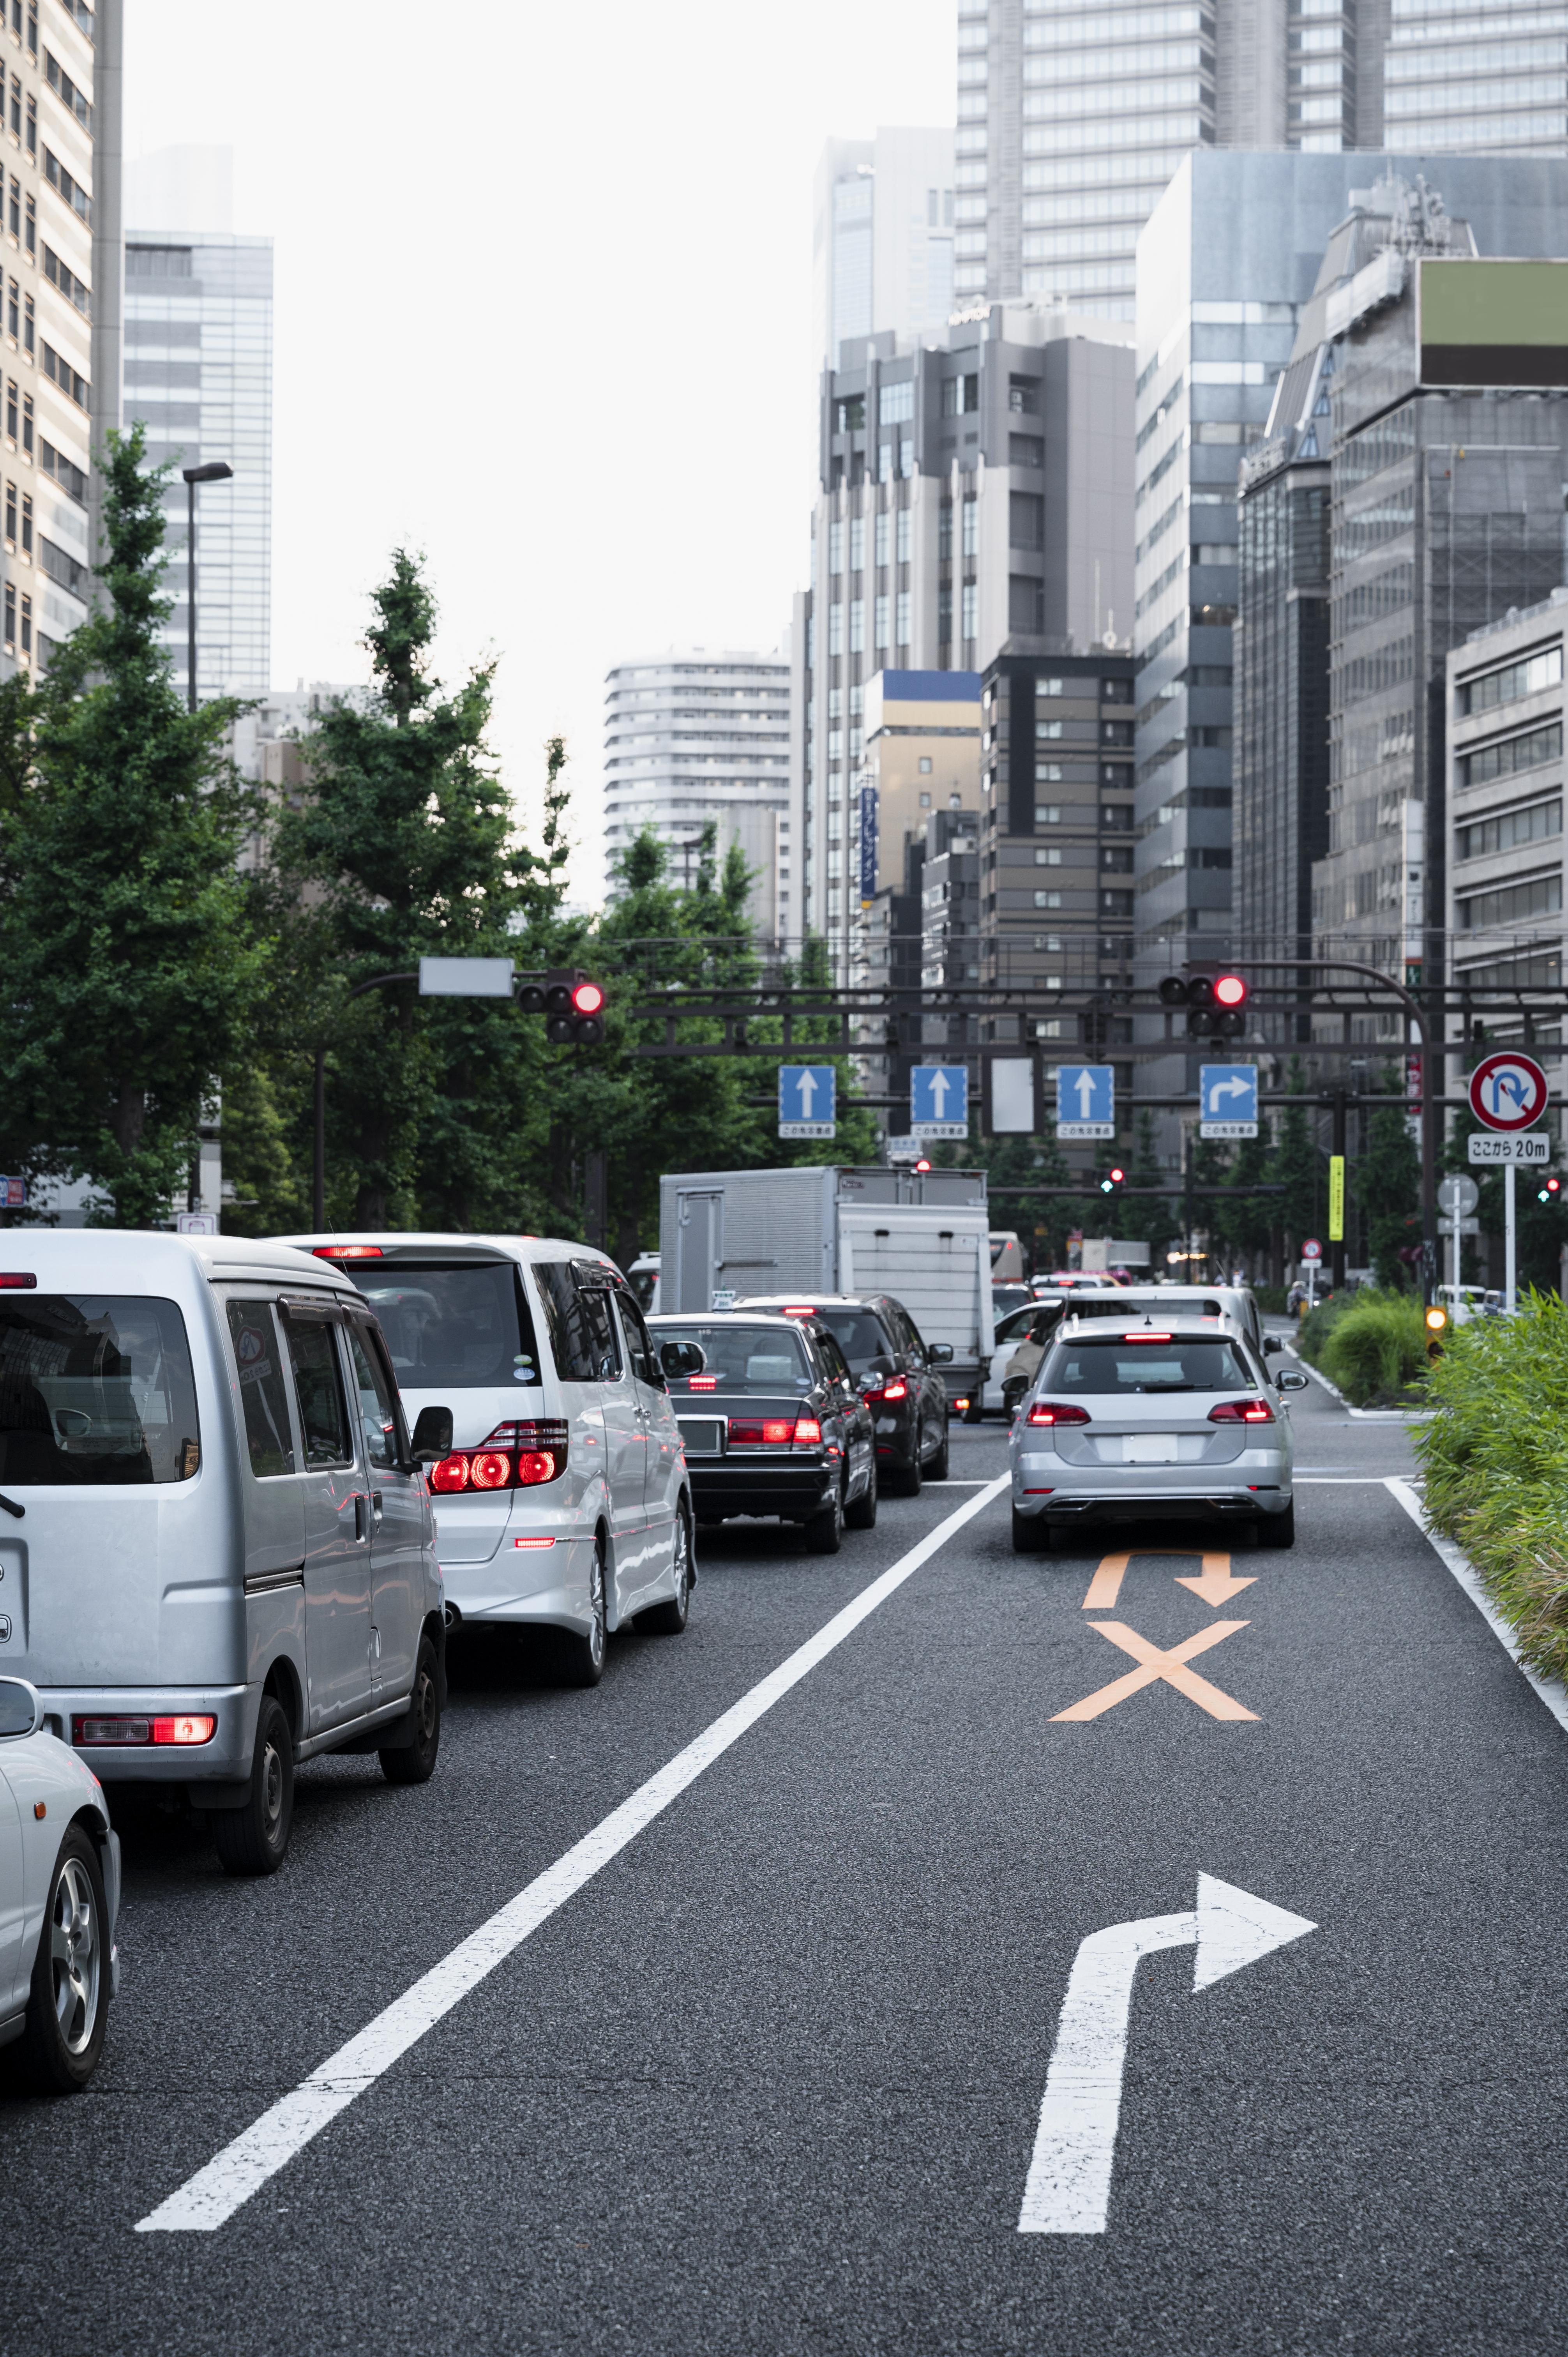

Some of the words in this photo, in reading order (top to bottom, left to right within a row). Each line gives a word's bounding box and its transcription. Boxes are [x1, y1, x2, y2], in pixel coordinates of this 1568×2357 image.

[1473, 1140, 1512, 1156] ここから
[1516, 1140, 1545, 1157] 20m
